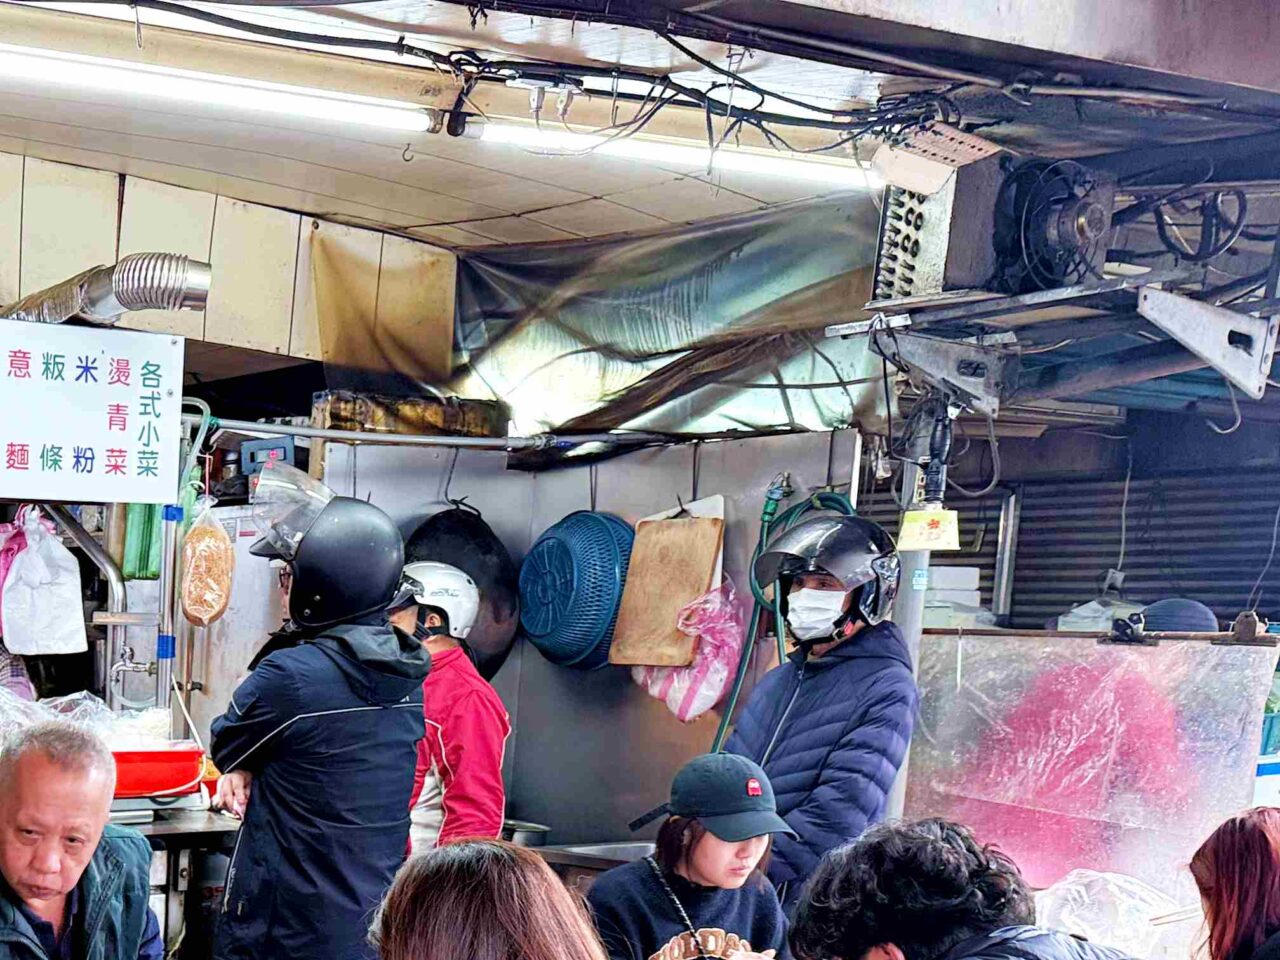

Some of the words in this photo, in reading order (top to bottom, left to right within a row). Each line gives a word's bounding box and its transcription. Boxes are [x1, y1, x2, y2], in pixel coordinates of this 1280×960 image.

[5, 349, 32, 471] 意麵
[39, 351, 66, 473] 粄條
[72, 355, 99, 474] 米粉
[137, 360, 162, 477] 各式小菜
